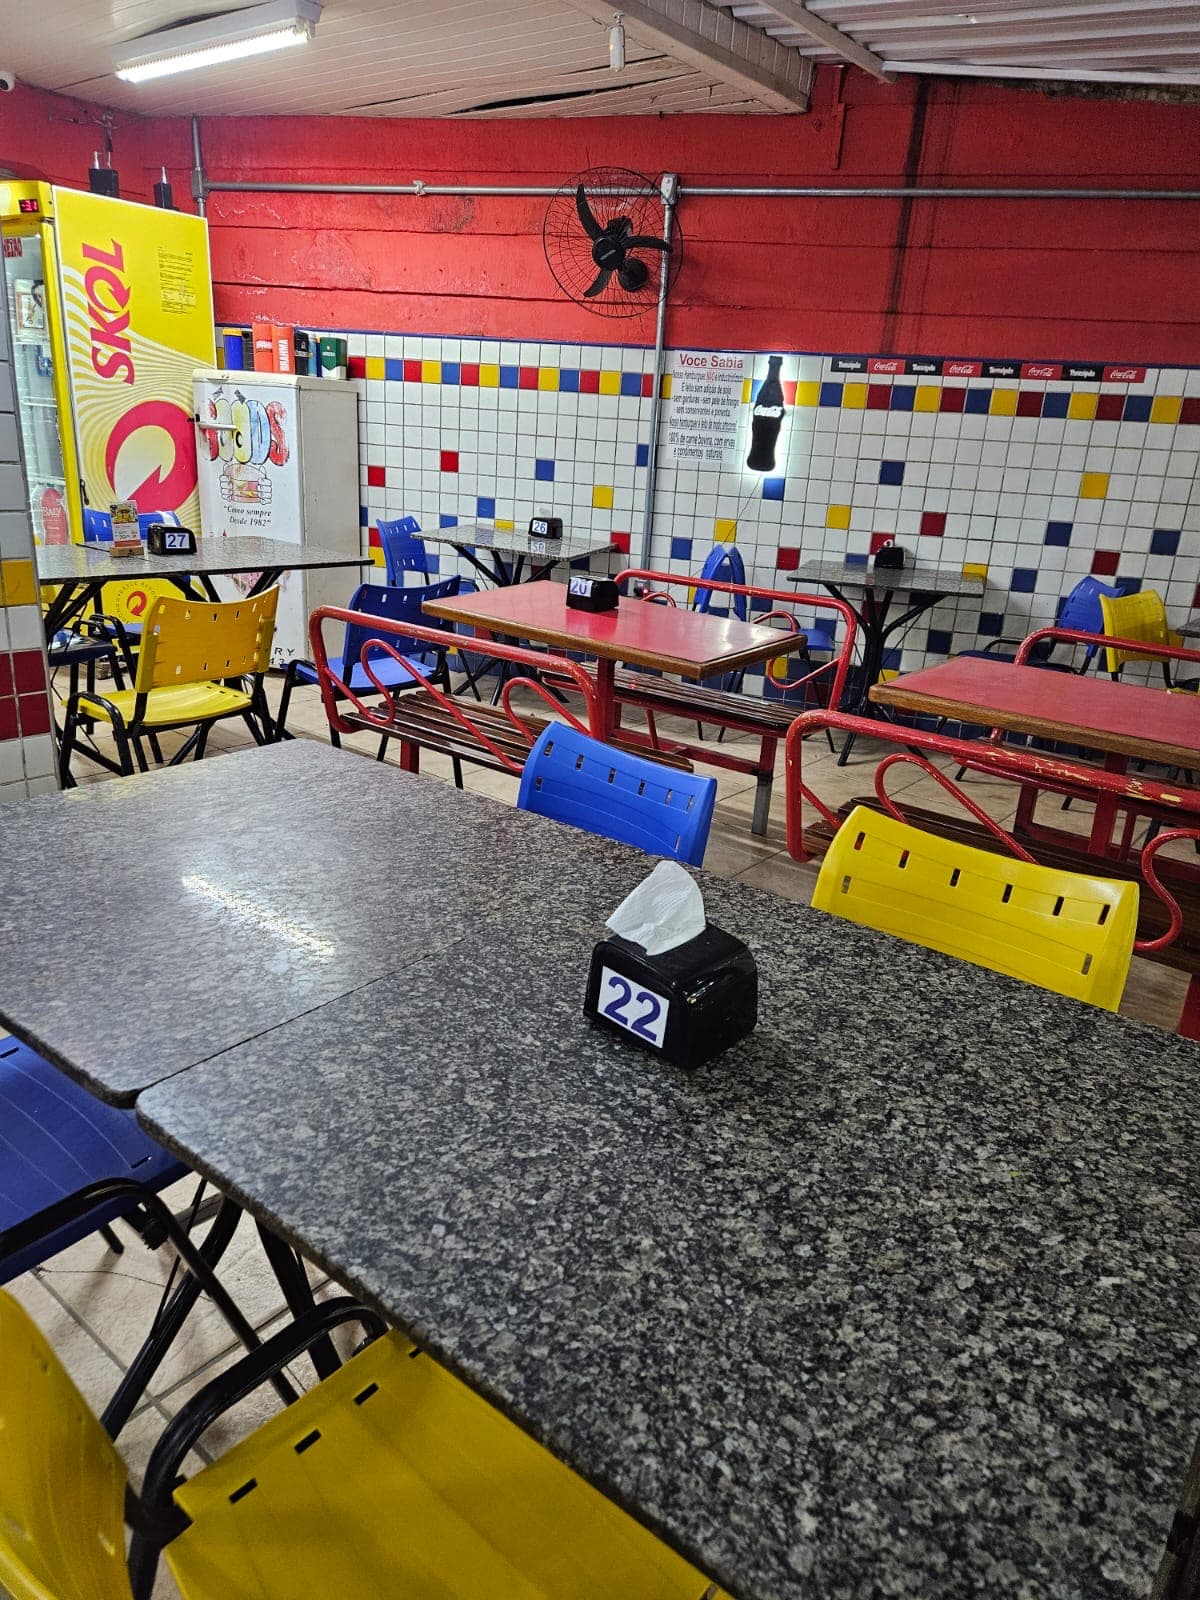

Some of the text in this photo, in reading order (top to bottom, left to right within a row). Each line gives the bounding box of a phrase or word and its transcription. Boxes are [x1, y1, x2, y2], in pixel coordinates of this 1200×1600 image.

[82, 238, 135, 385] SKOL
[278, 339, 289, 371] BRAHMA
[680, 353, 743, 369] Voce Sabia
[229, 516, 248, 525] Desde
[246, 509, 272, 518] sempre
[534, 521, 546, 533] 26
[167, 534, 186, 547] 27
[571, 578, 588, 594] 20
[604, 976, 661, 1042] 22
